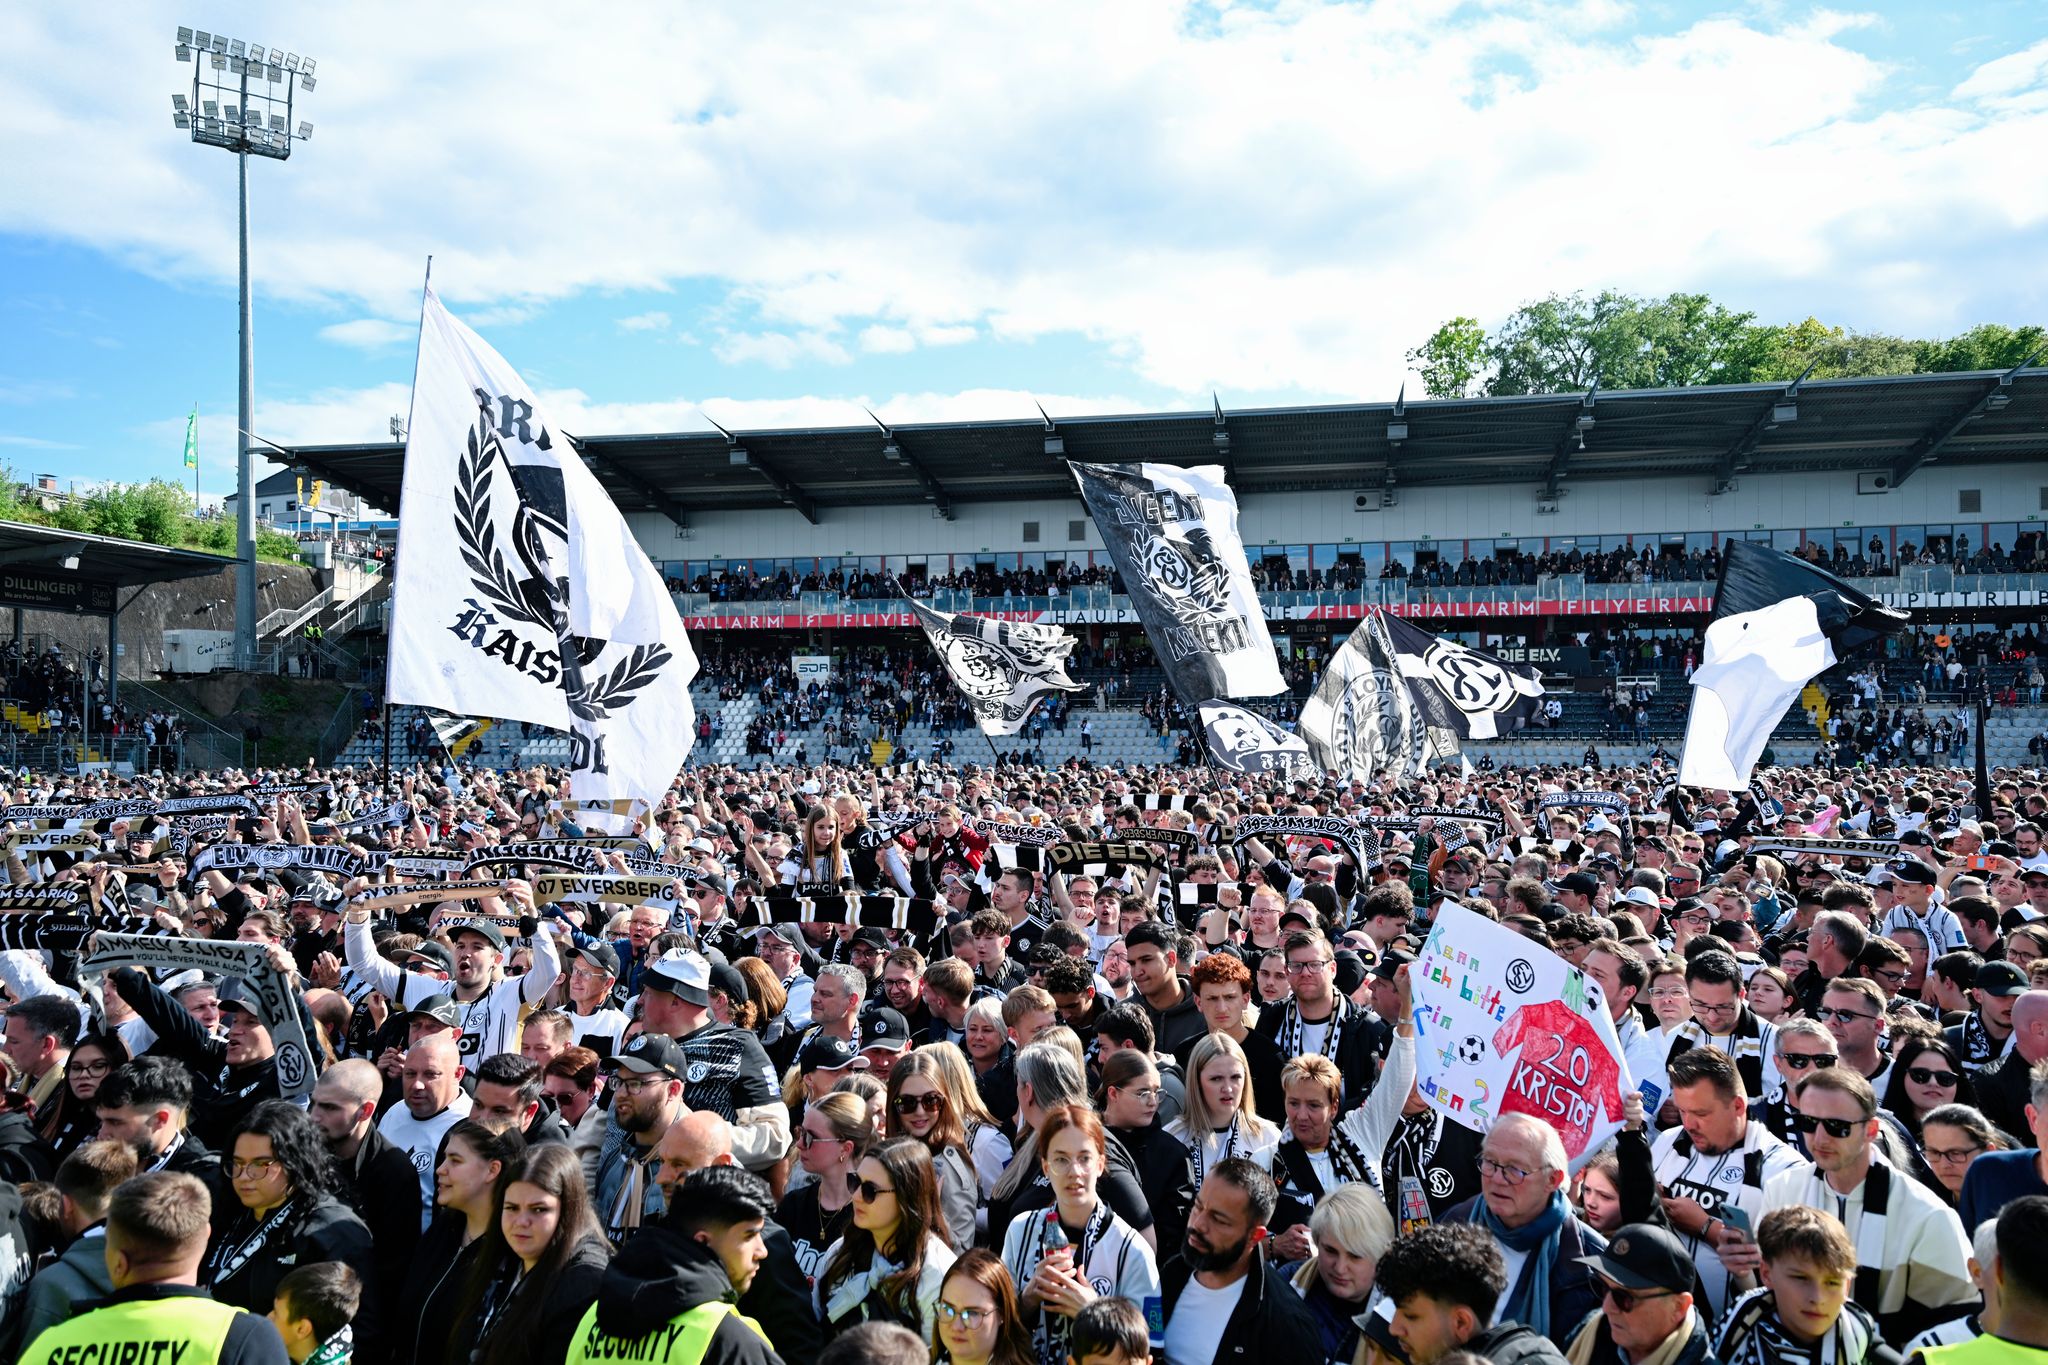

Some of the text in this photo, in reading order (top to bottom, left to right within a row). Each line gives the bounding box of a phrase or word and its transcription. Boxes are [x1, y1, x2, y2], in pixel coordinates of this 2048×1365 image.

[4, 576, 76, 595] DILLINGER
[1496, 648, 1527, 662] DIE
[174, 795, 246, 810] ELVERSBERG
[213, 846, 249, 867] ELV
[414, 859, 442, 869] DEM
[1050, 843, 1098, 865] DIE
[537, 878, 674, 901] 07 ELVERSBERG
[452, 917, 465, 926] 07
[1425, 922, 1479, 972] Kann
[168, 954, 198, 965] NEVER
[198, 957, 221, 969] WALK
[1422, 955, 1452, 988] ich
[1459, 974, 1507, 1023] bitte
[1540, 1034, 1591, 1087] 20
[48, 1339, 191, 1365] SECURITY
